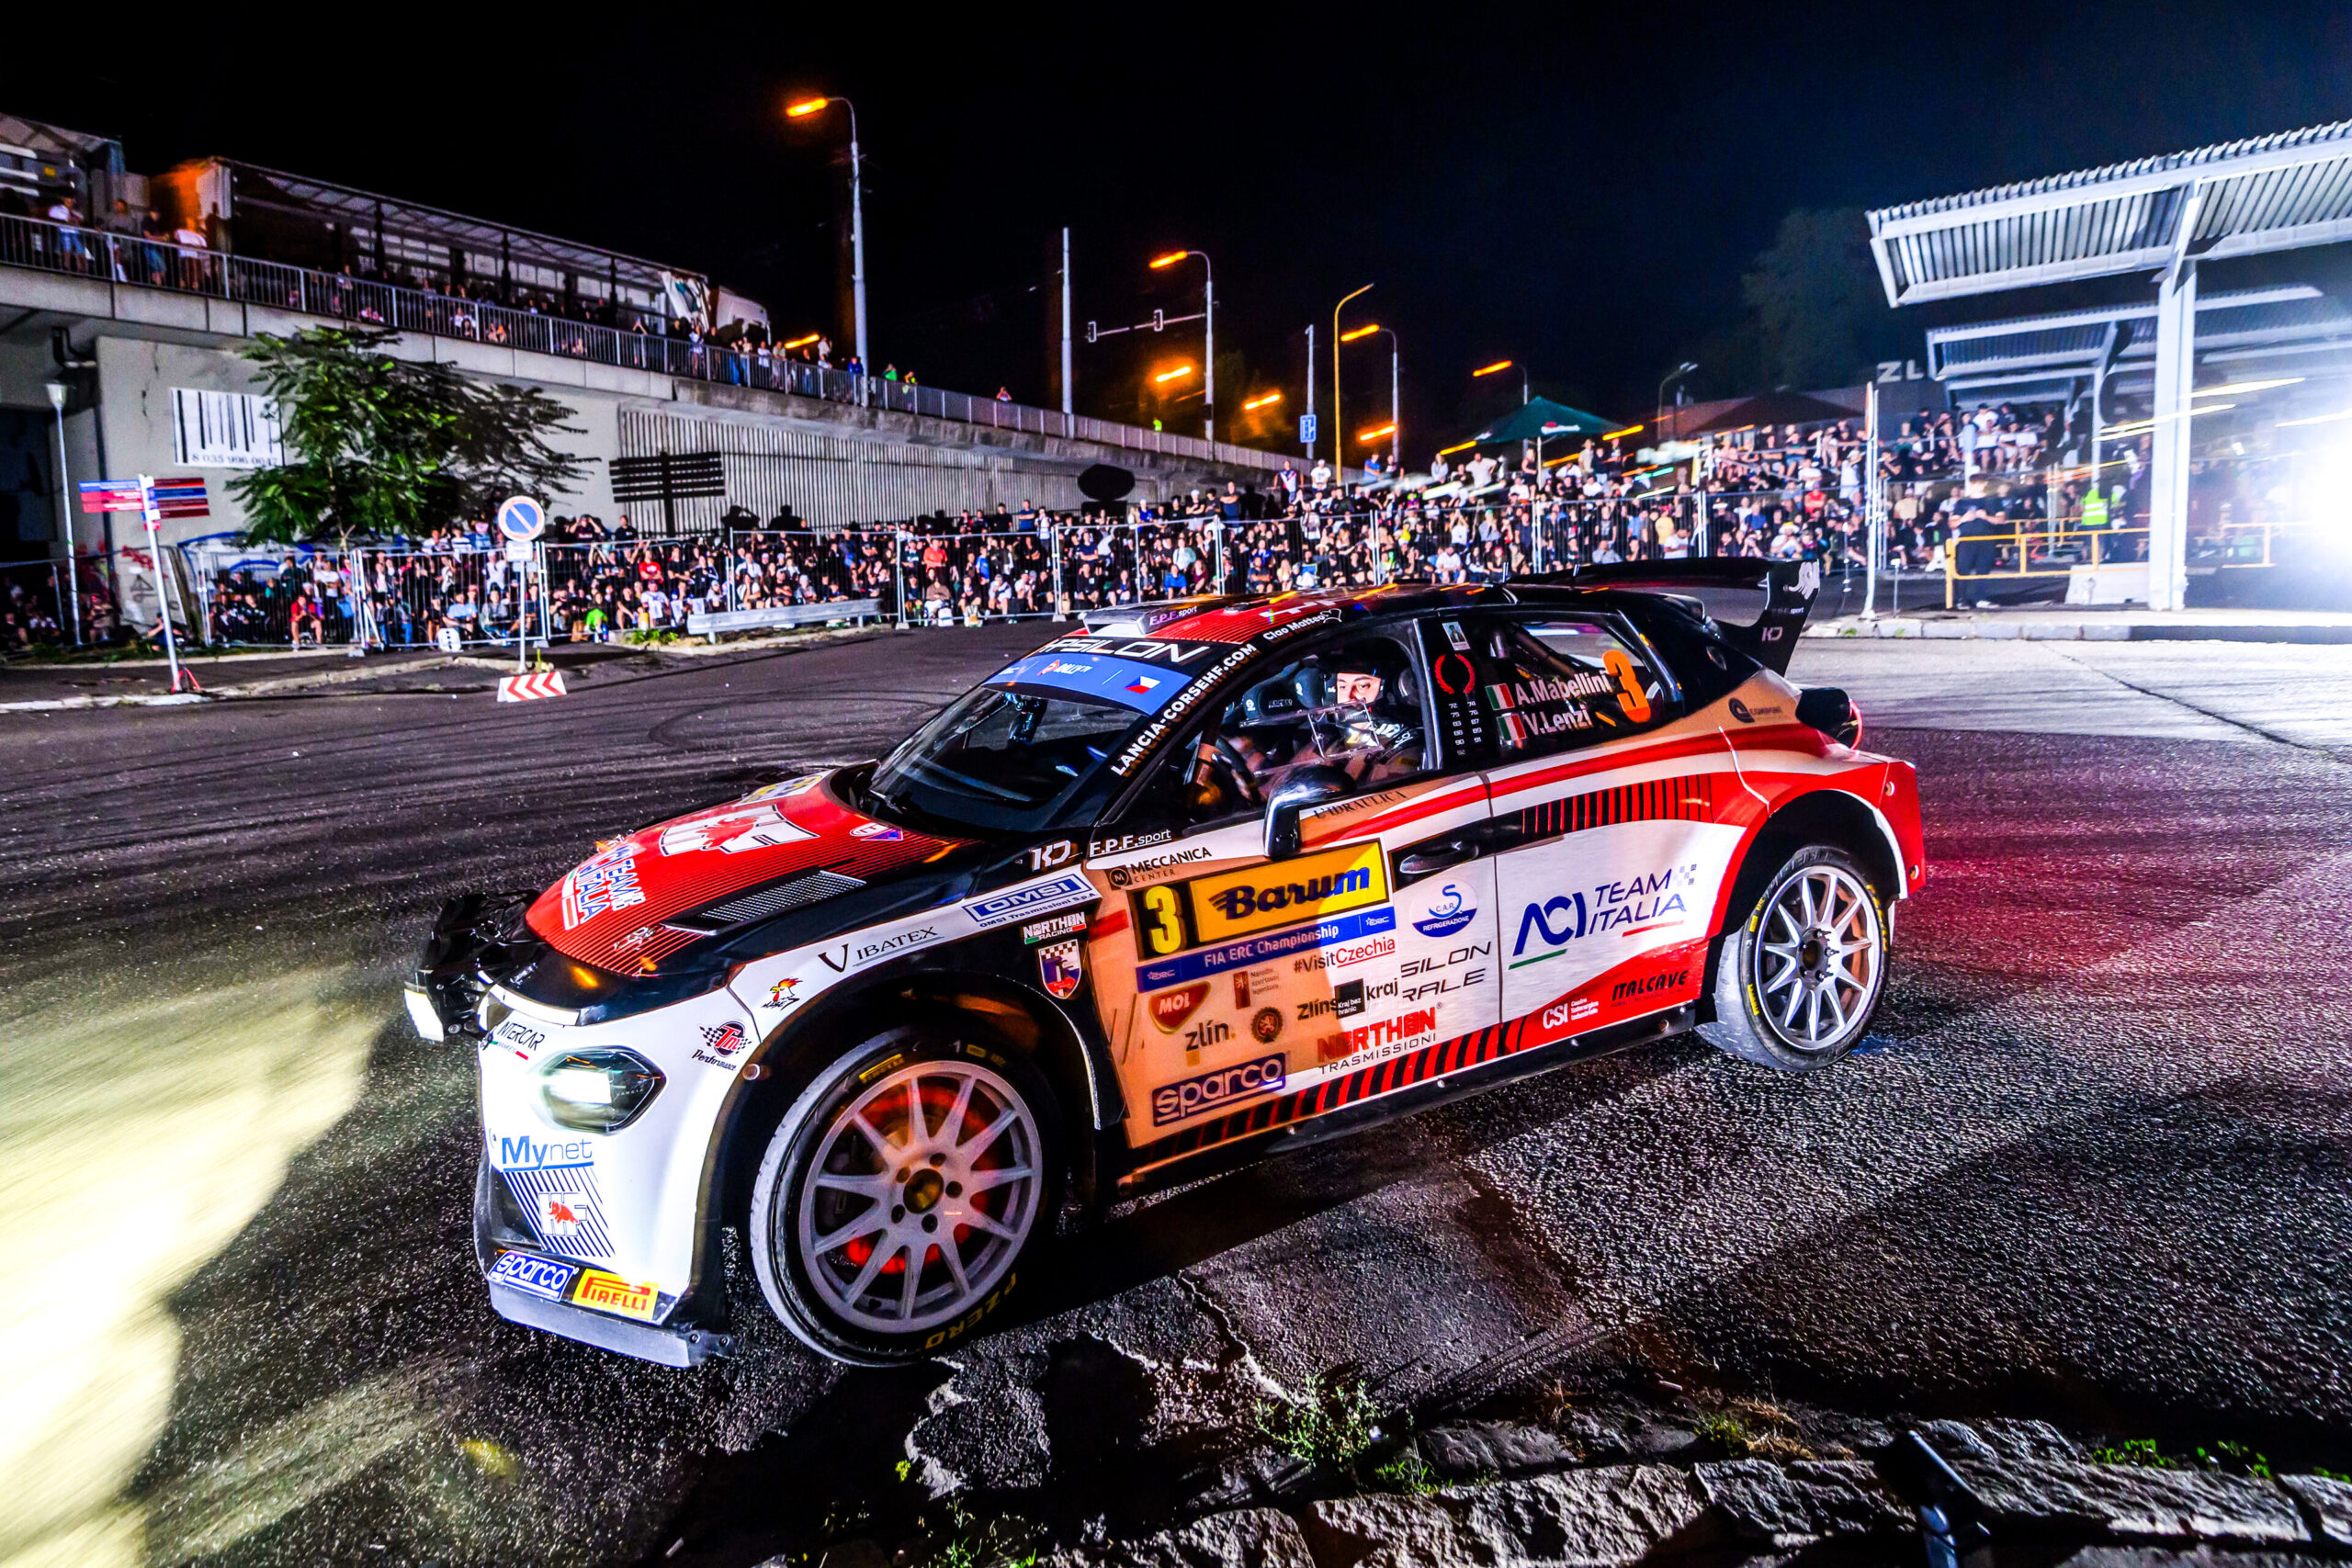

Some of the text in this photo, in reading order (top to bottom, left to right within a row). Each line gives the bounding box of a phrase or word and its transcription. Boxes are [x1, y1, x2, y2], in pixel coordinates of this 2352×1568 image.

[1516, 670, 1611, 706] A.Mabellini
[1602, 649, 1651, 724] 3
[1110, 643, 1258, 777] LANCIA-CORSEHF.COM
[1522, 705, 1594, 736] V.Lenzi
[1130, 846, 1213, 875] MECCANICA
[1134, 868, 1176, 883] CENTER
[984, 878, 1071, 912] OMSI
[1208, 866, 1371, 920] Barum
[1595, 868, 1672, 908] TEAM
[1145, 886, 1182, 954] 3
[1513, 891, 1587, 956] ACI
[1589, 893, 1687, 935] ITALIA
[1039, 928, 1073, 940] RACING
[1204, 924, 1340, 967] FIA ERC Championship
[1293, 936, 1396, 974] #VisitCzechia
[1365, 978, 1398, 1000] kraj
[1611, 969, 1690, 1001] ITALCAVE
[1159, 992, 1191, 1015] MOL
[1543, 1003, 1568, 1030] CSI
[1318, 1033, 1437, 1075] TRASMISSIONI
[1156, 1058, 1283, 1118] sparco
[502, 1135, 593, 1170] Mynet
[496, 1254, 570, 1291] sparco
[581, 1276, 651, 1312] PIRELLI
